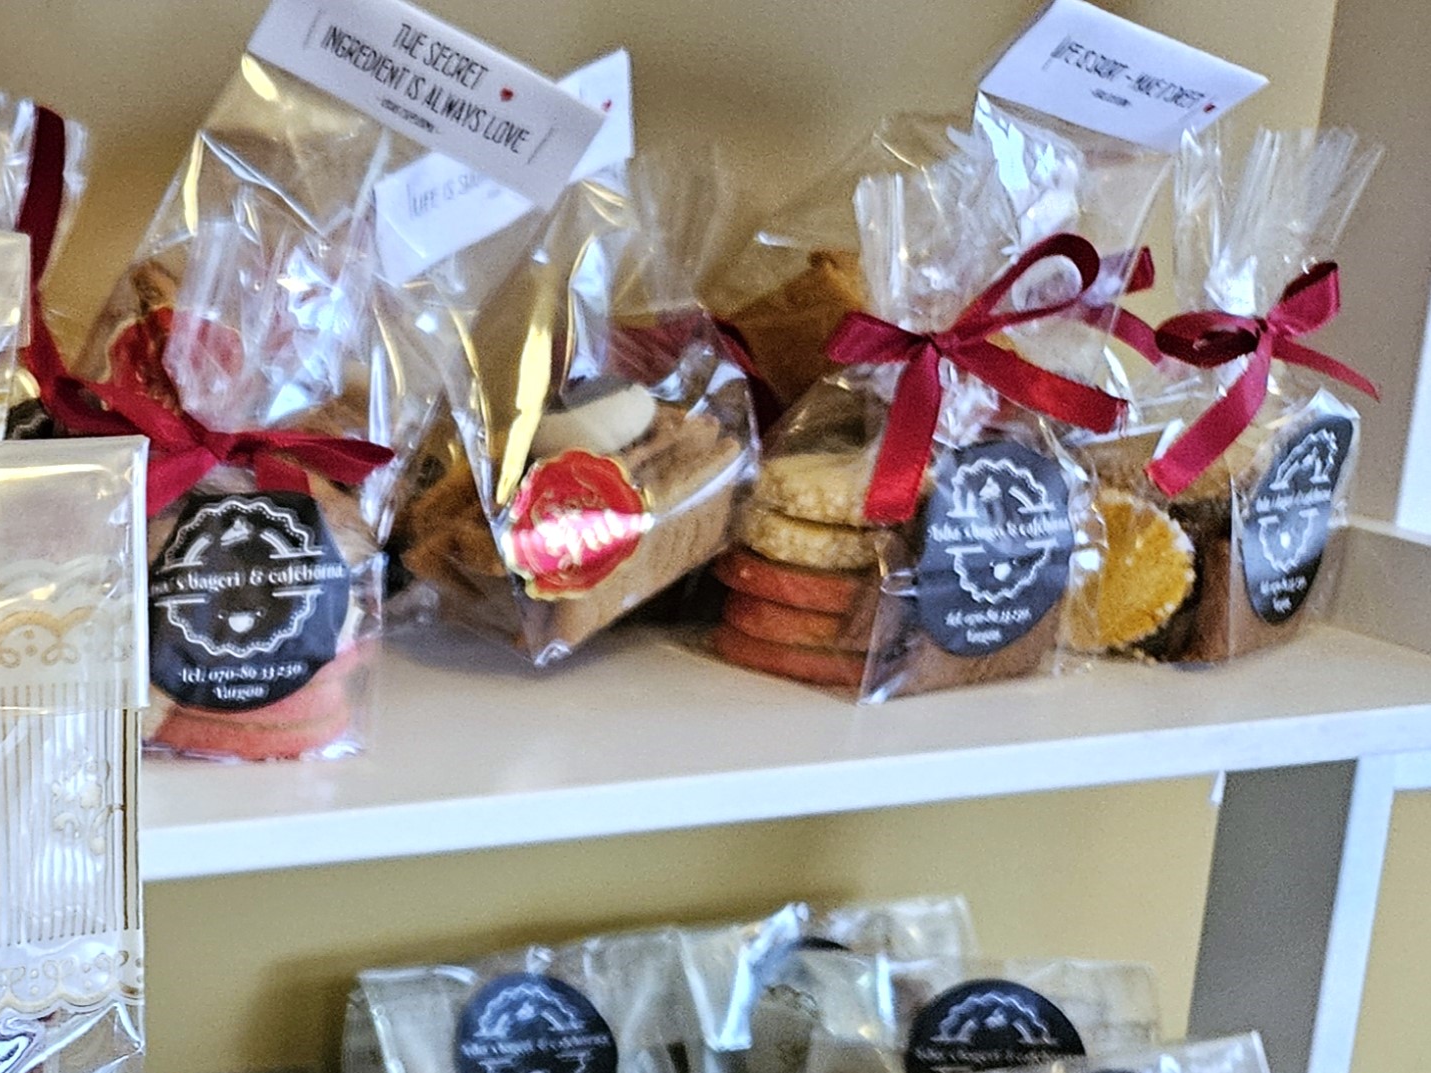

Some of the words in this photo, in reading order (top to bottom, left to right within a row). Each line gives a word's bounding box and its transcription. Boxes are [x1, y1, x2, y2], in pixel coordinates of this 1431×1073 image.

[321, 24, 410, 91] INGREDIENT
[406, 73, 425, 101] IS
[423, 84, 488, 133] ALWAYS
[483, 116, 531, 154] LOVE
[393, 23, 427, 60] THE
[423, 41, 489, 90] SECRET
